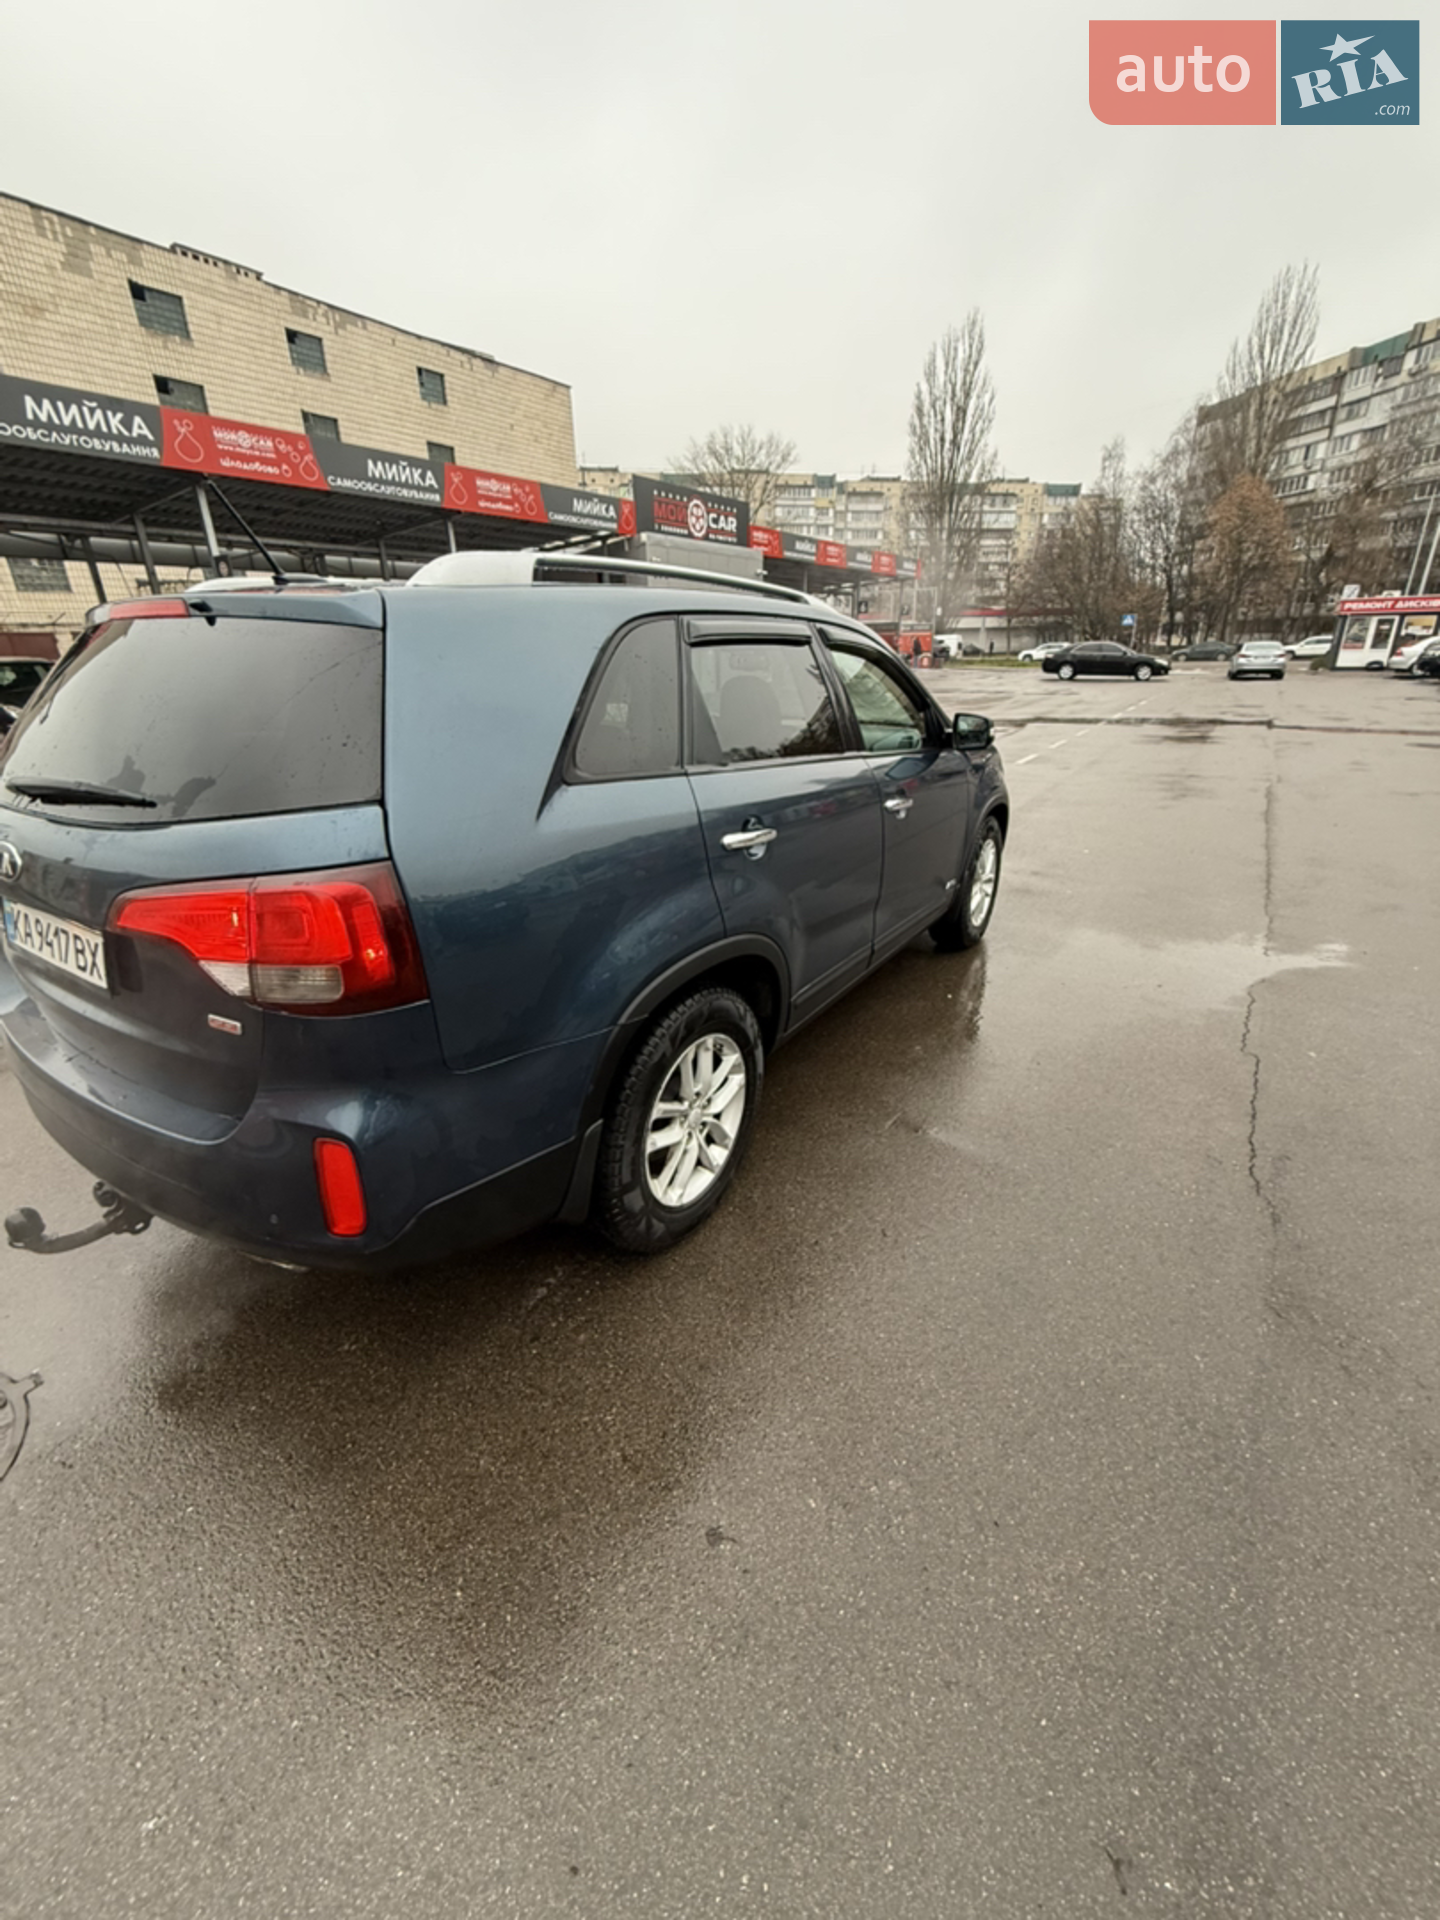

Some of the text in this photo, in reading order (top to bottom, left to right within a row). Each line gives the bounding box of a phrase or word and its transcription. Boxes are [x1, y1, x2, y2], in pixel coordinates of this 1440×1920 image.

[24, 394, 155, 442] МИЙКА
[367, 458, 439, 489] МИЙКА
[573, 496, 617, 519] МИЙКА
[708, 512, 737, 533] CAR
